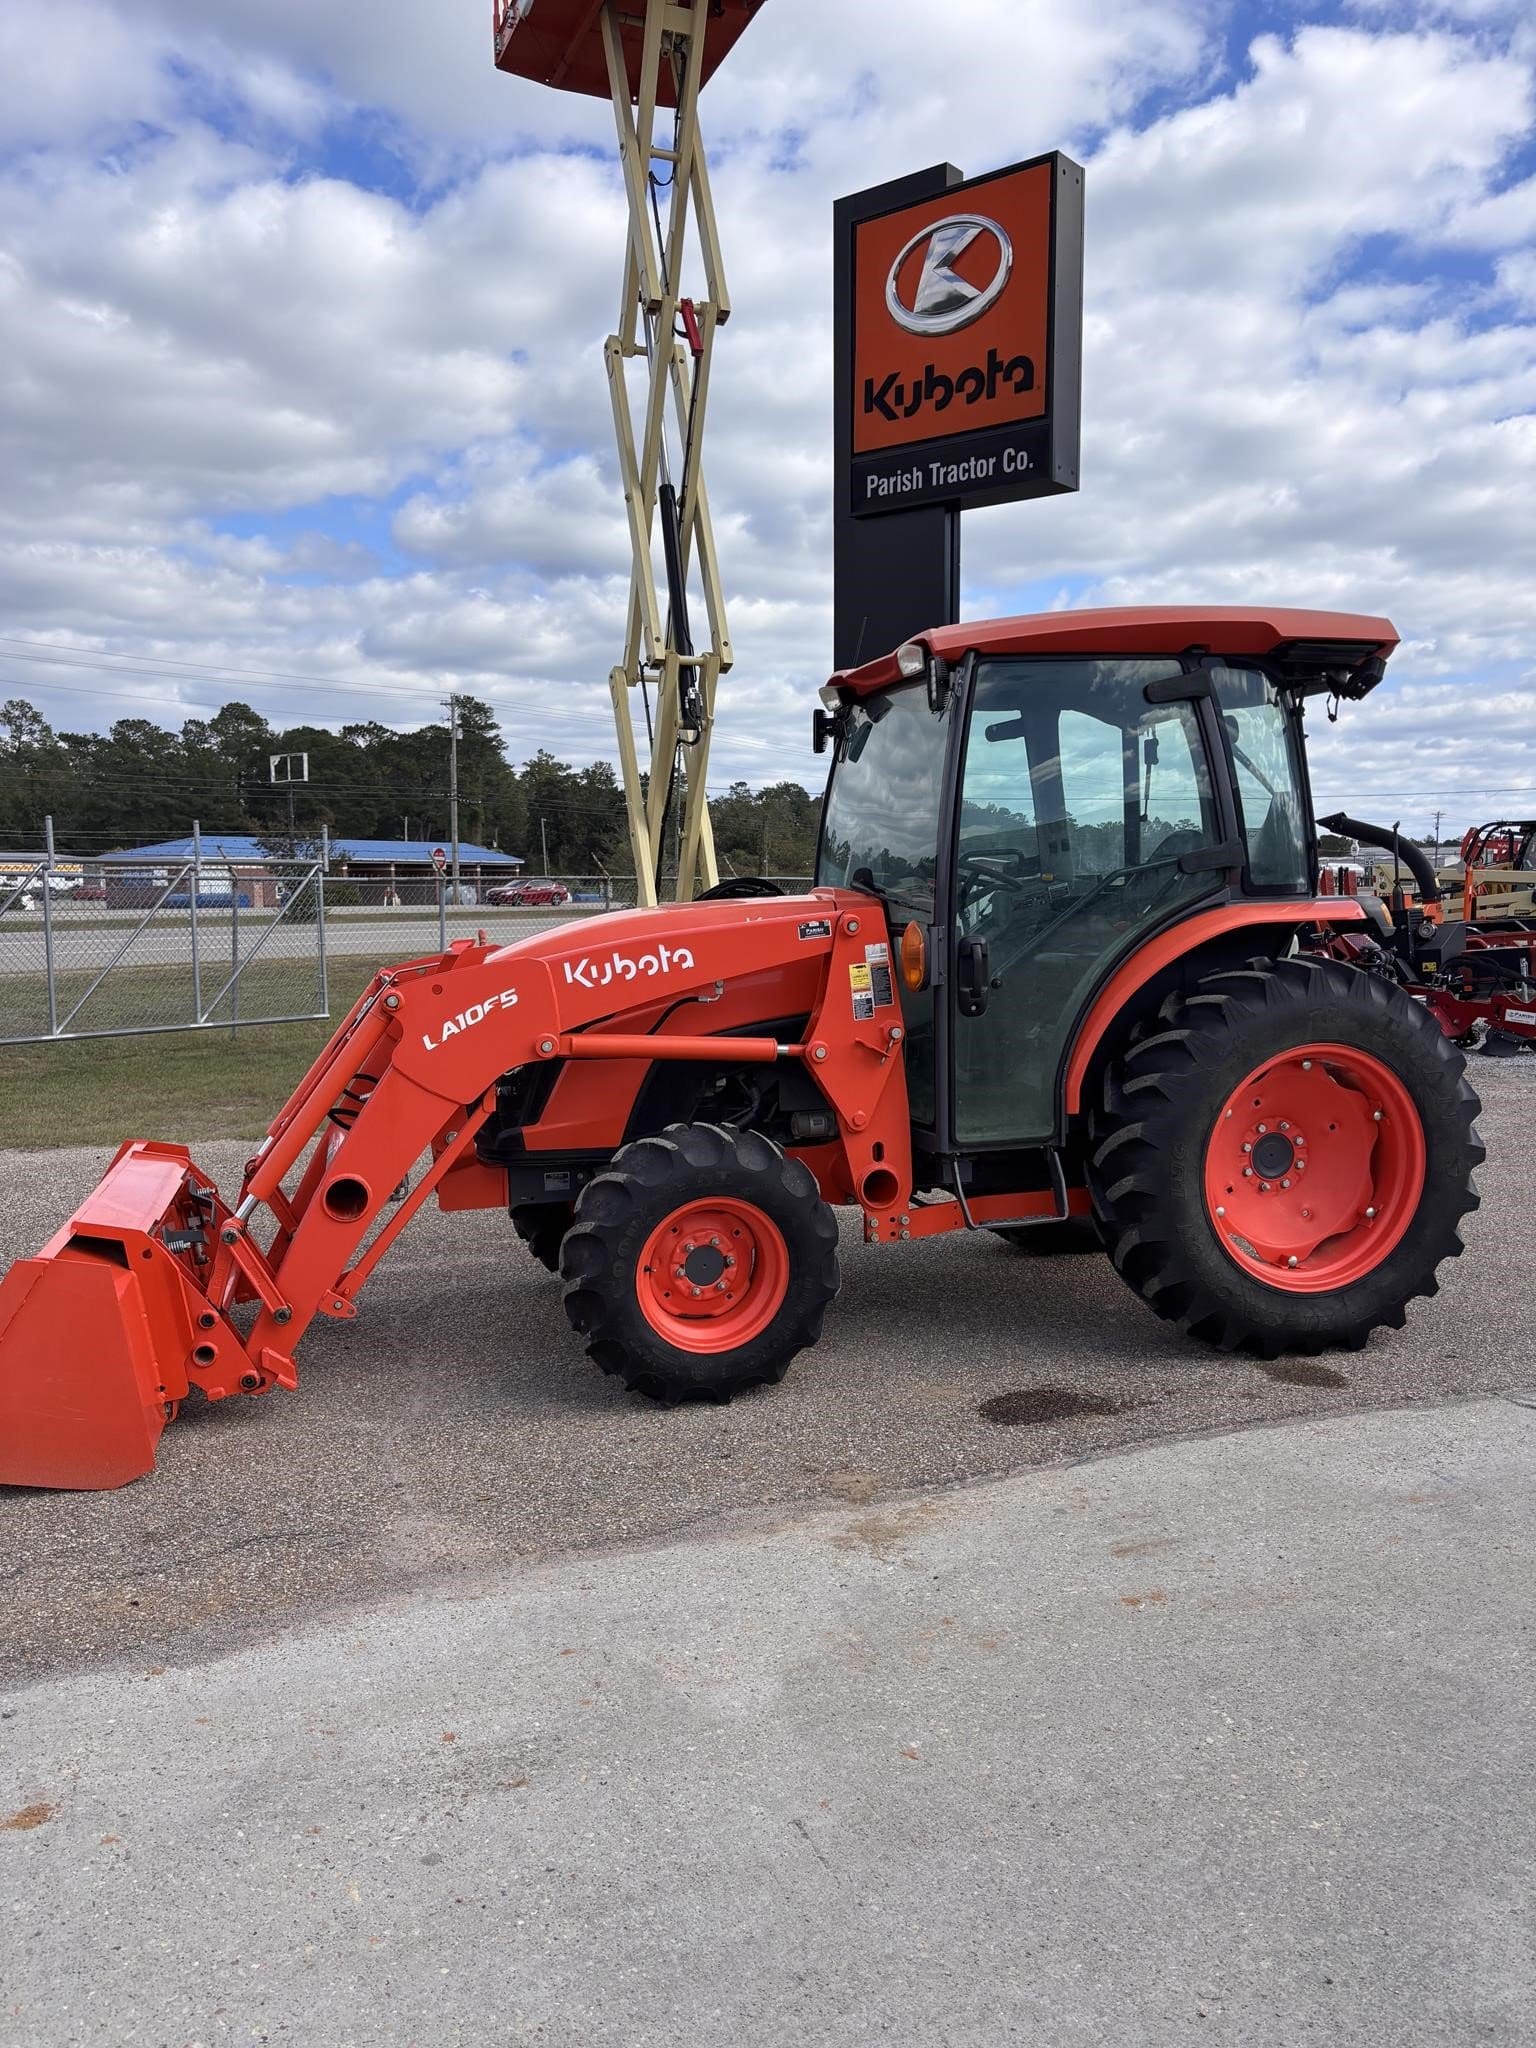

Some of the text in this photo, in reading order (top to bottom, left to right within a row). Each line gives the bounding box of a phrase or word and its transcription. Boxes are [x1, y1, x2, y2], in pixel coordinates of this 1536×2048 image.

[863, 347, 1036, 422] Kubota
[866, 447, 1034, 499] Parish Tractor Co.
[563, 944, 695, 988] Kubota
